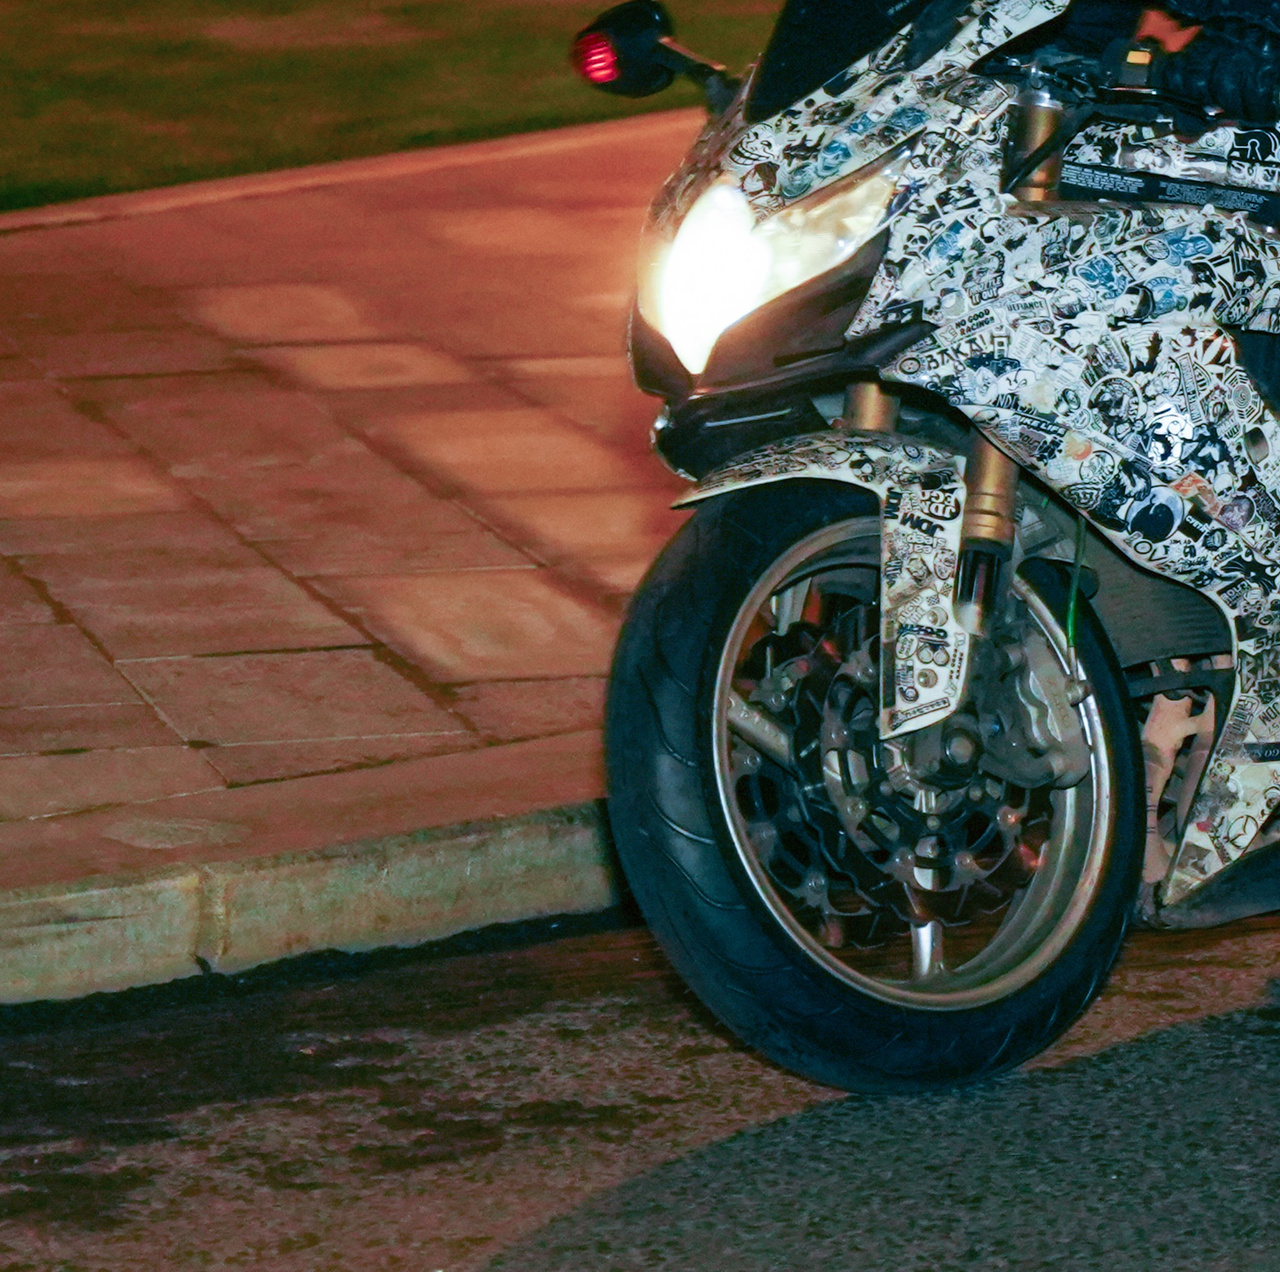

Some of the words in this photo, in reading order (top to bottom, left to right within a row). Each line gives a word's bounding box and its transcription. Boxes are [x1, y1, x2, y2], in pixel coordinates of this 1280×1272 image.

[981, 288, 999, 301] OUT
[955, 319, 967, 329] NO
[967, 308, 991, 323] GOOD
[925, 333, 988, 371] BAKA!
[1258, 702, 1280, 726] JDM
